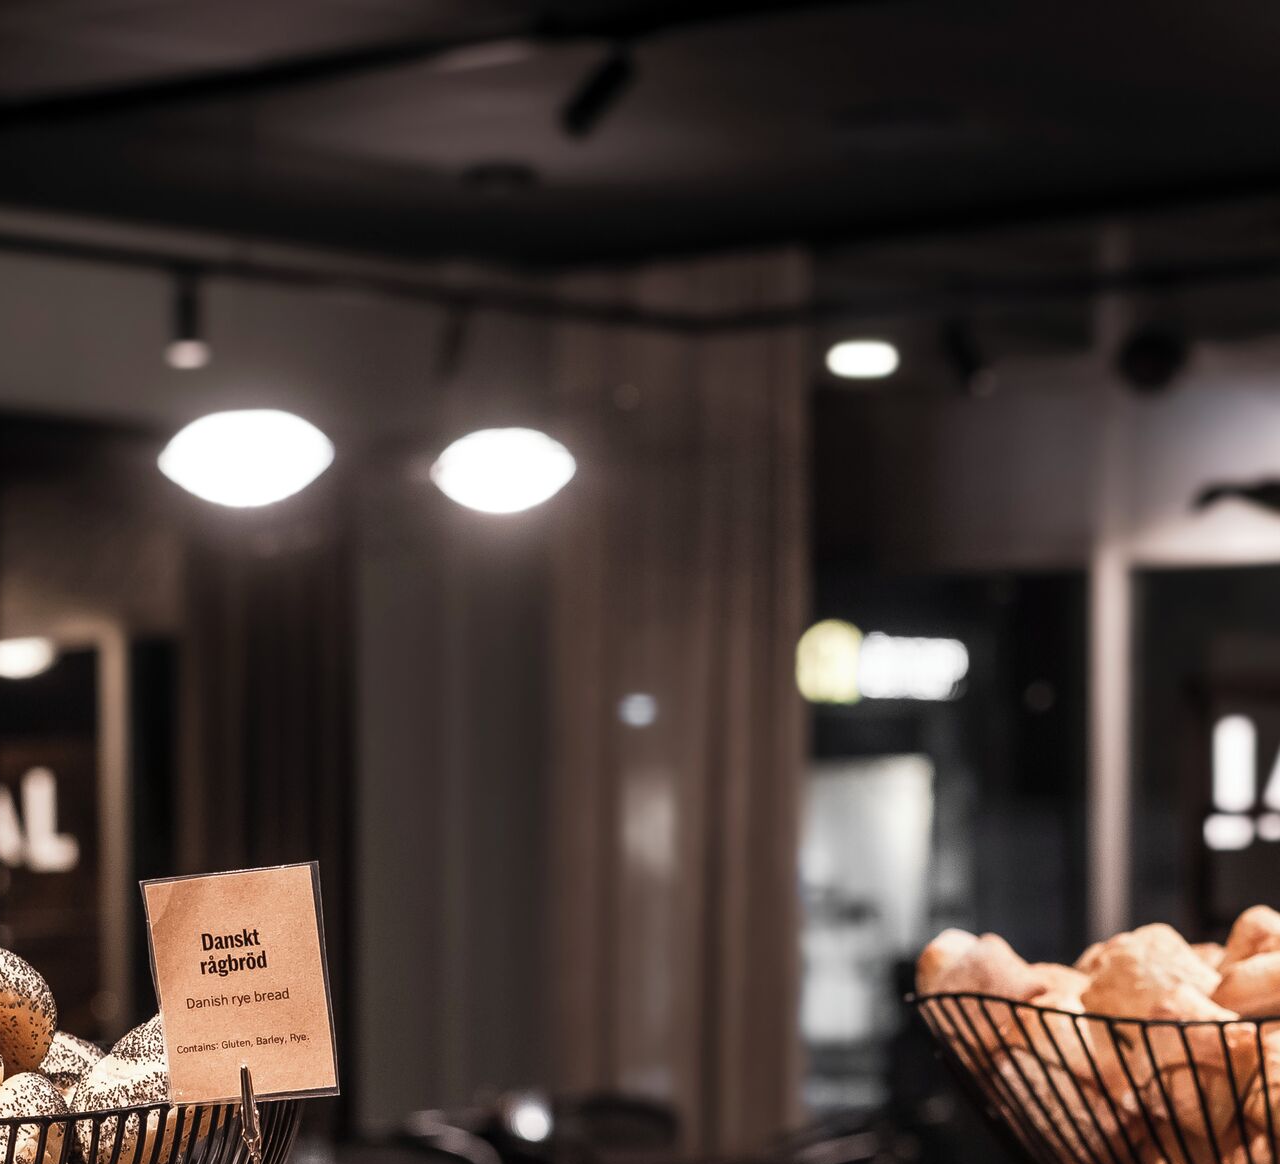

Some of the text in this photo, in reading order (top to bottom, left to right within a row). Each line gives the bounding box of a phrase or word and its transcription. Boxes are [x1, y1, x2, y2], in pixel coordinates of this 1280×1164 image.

[201, 928, 261, 951] Danskt
[200, 950, 267, 977] rågbröd
[186, 987, 290, 1009] Danish rye bread
[176, 1033, 310, 1054] Contains: Gluten, Barley, Rye.
